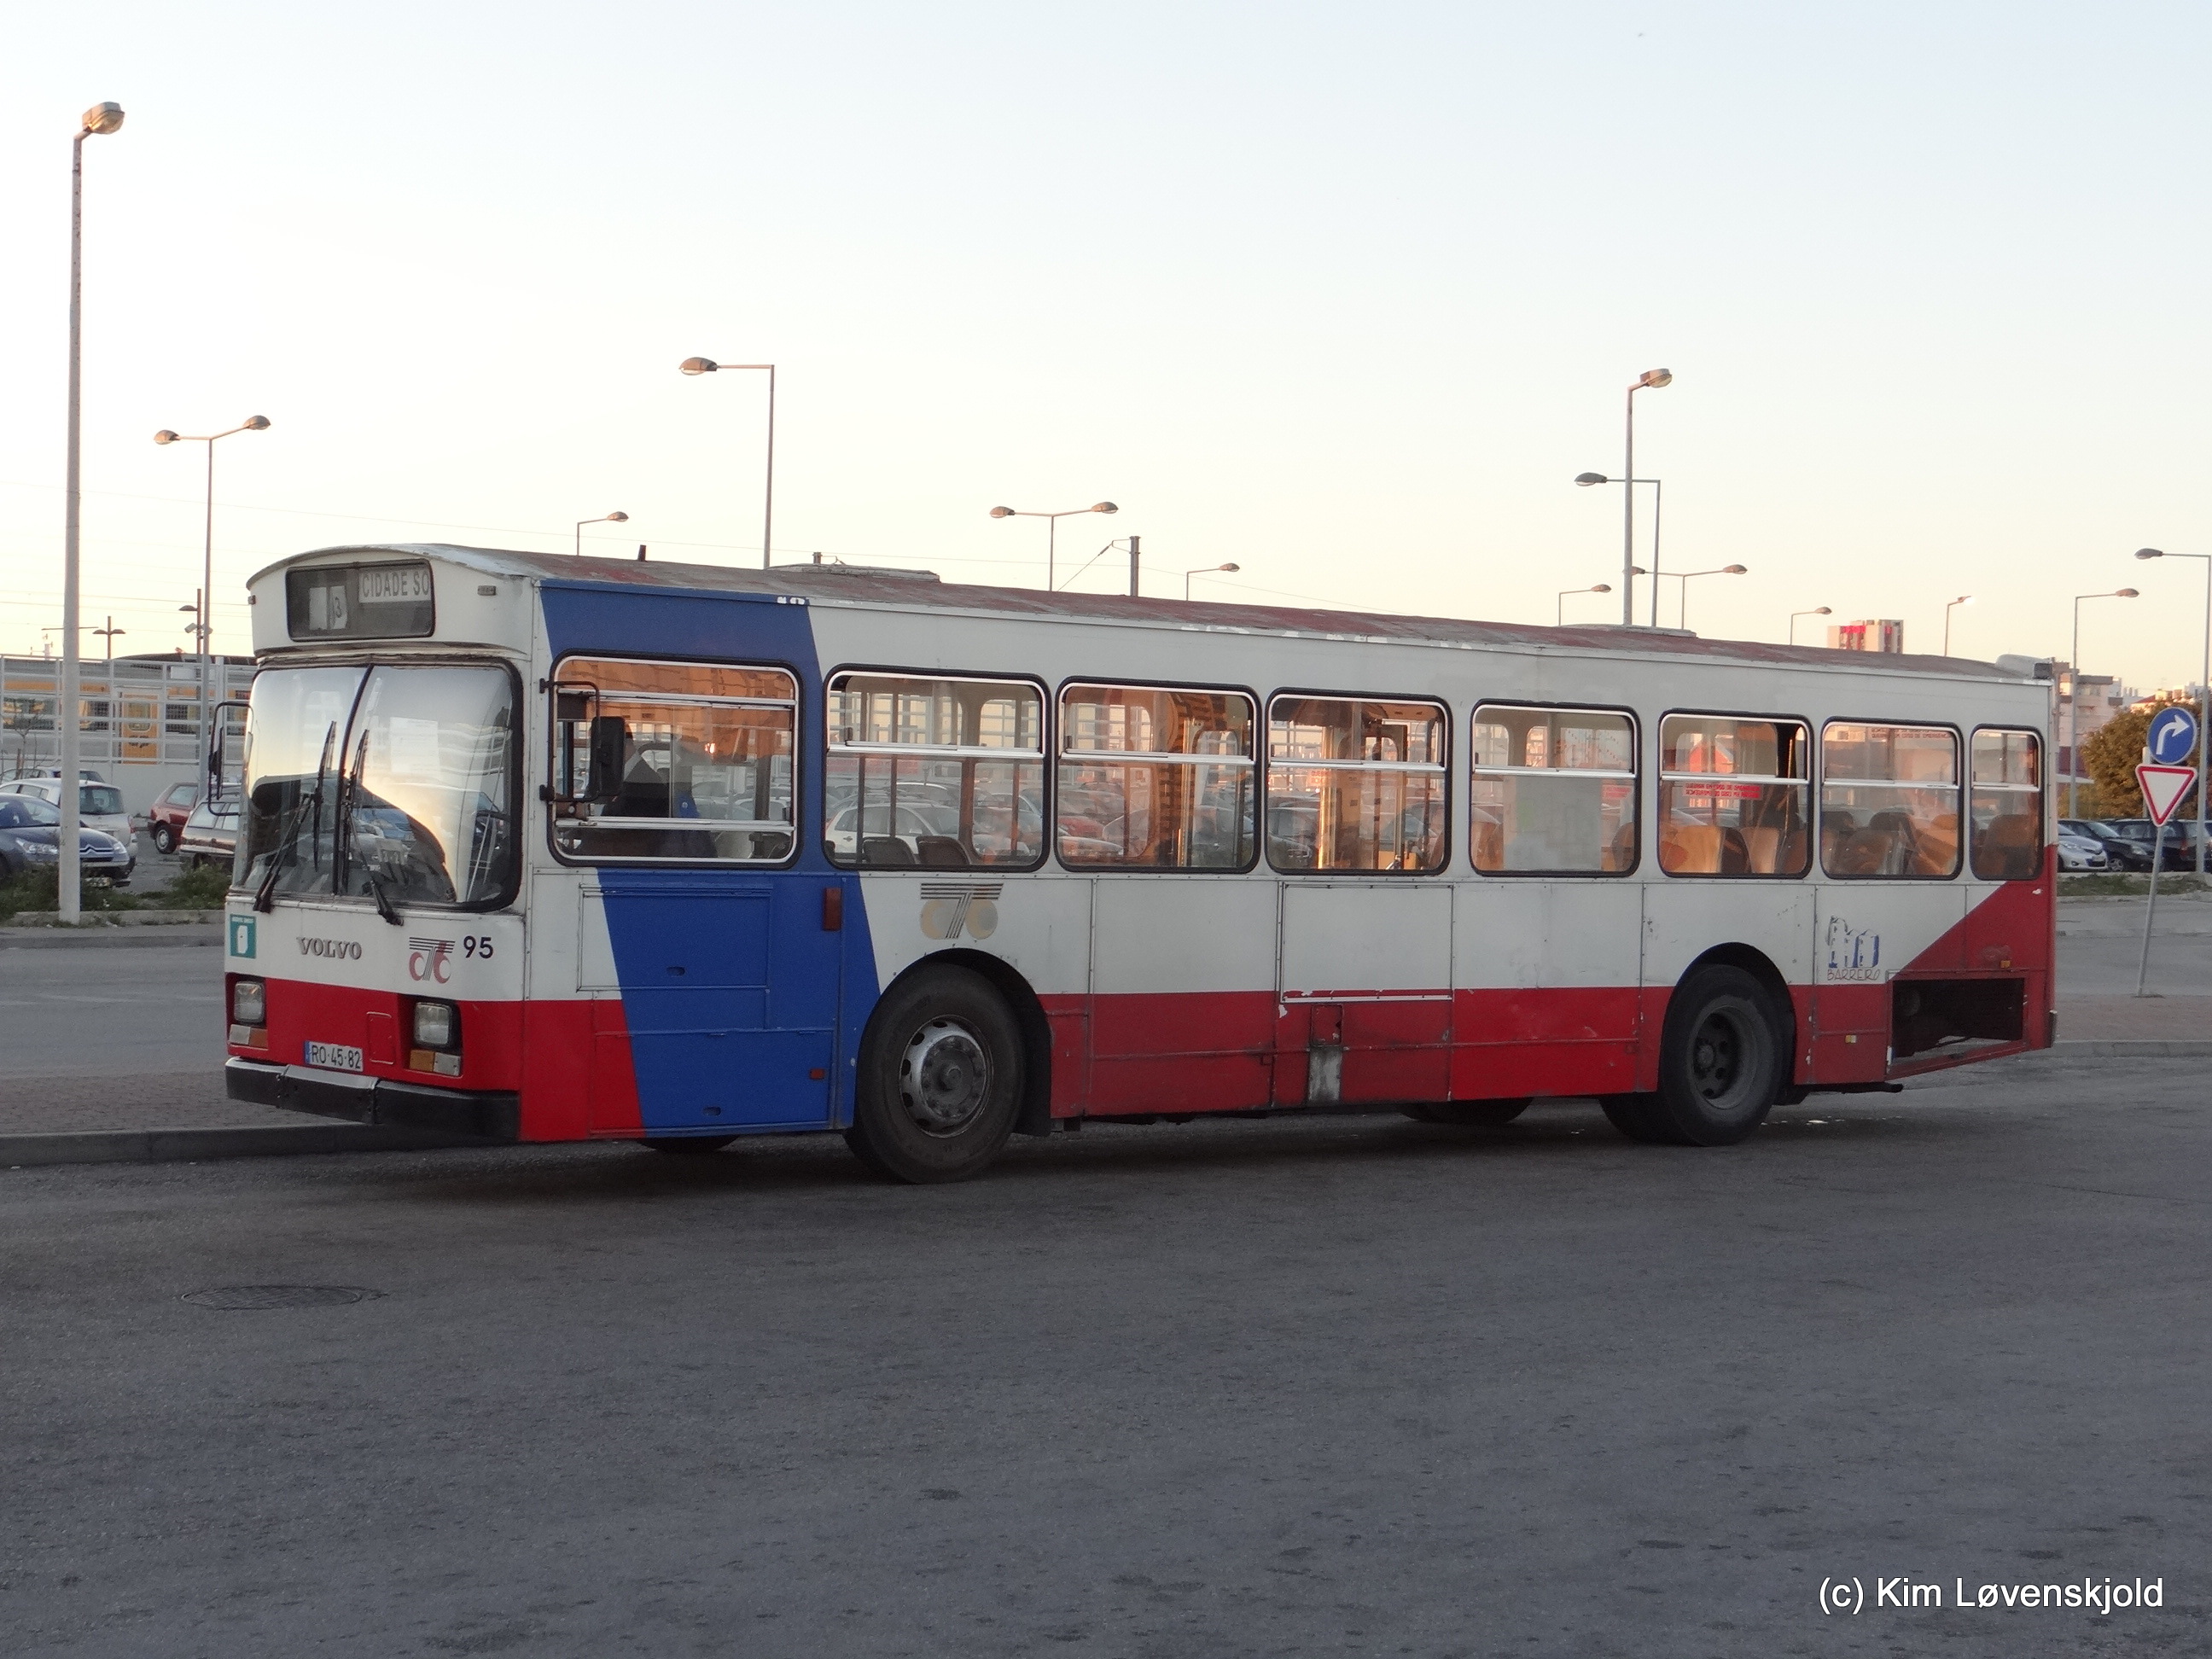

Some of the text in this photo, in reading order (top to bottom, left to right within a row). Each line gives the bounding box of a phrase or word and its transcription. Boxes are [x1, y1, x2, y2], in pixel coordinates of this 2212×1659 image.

[363, 572, 408, 597] CIDADE
[296, 937, 362, 960] VOLVO
[463, 935, 494, 959] 95
